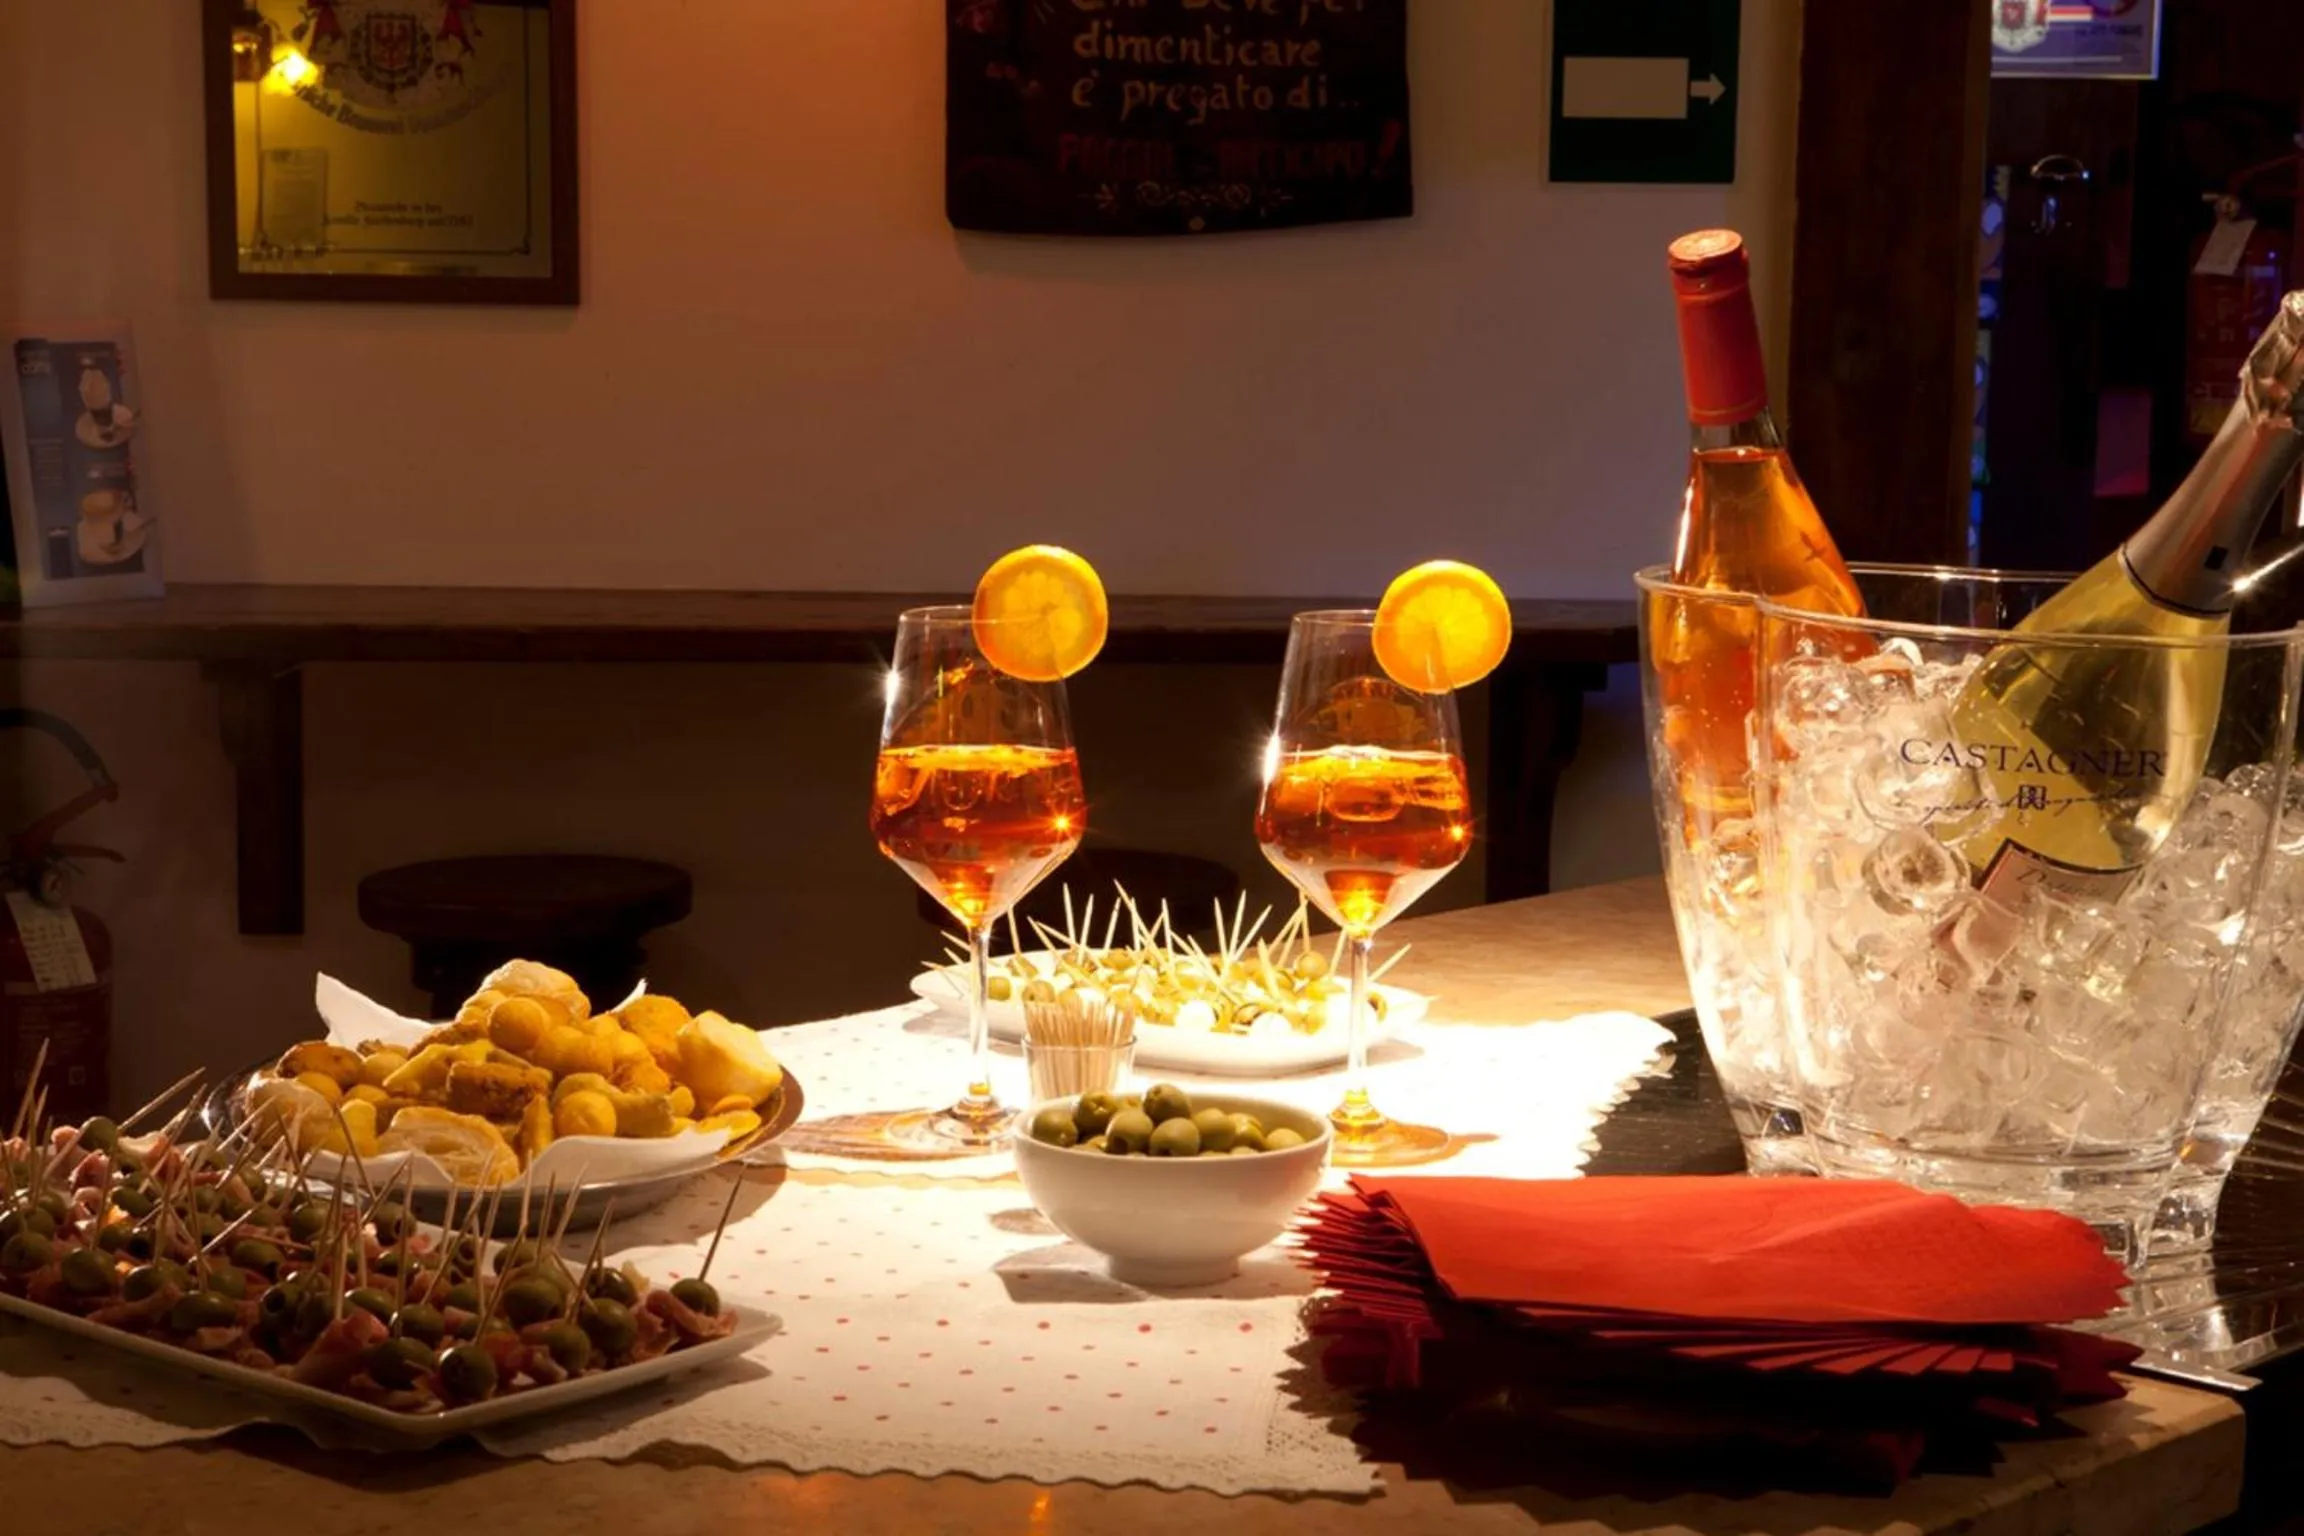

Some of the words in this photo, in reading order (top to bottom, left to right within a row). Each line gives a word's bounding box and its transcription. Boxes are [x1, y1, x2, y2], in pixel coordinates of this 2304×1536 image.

[1073, 19, 1322, 67] dimenticare
[1120, 73, 1274, 126] pregato
[1900, 738, 2165, 778] CASTAGNER
